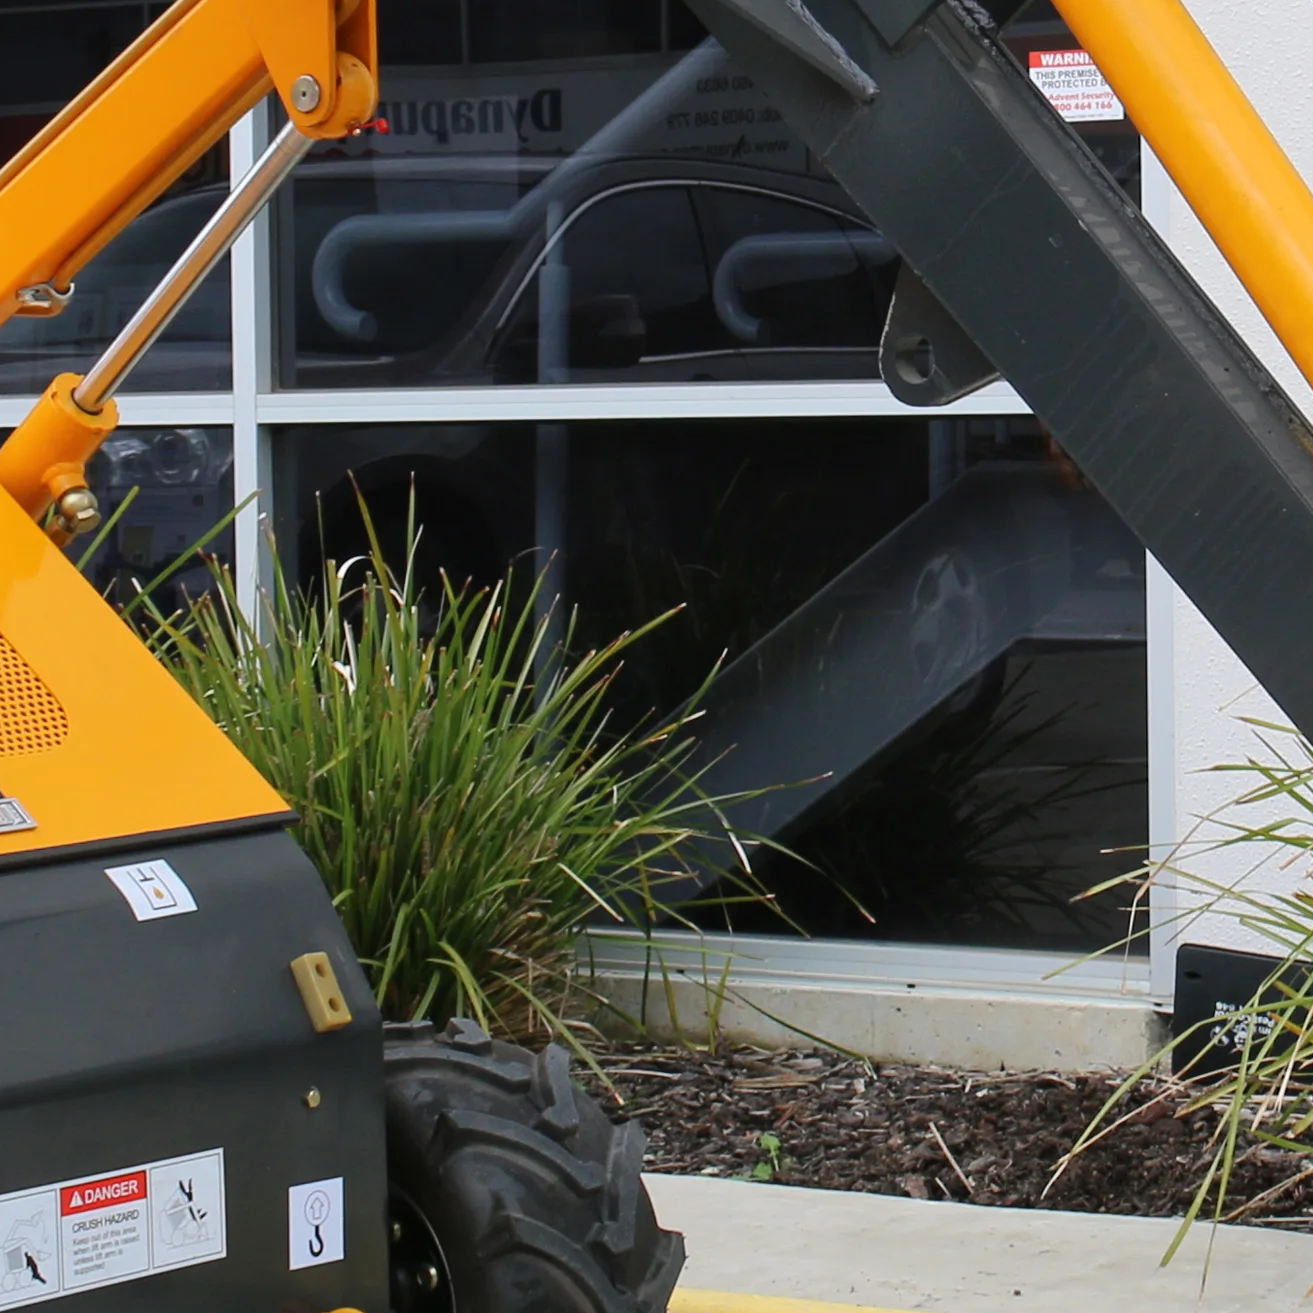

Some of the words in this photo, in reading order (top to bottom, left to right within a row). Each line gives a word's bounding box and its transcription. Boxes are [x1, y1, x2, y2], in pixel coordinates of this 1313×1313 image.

[1040, 52, 1094, 66] WARNI
[1035, 71, 1056, 80] THIS
[1058, 69, 1102, 79] PREMISE
[1042, 79, 1098, 89] PROTECTED
[1048, 92, 1079, 101] Advent
[1081, 91, 1116, 101] Security
[85, 1179, 139, 1204] DANGER
[72, 1218, 103, 1233] CRUSH
[104, 1210, 139, 1226] HAZARD
